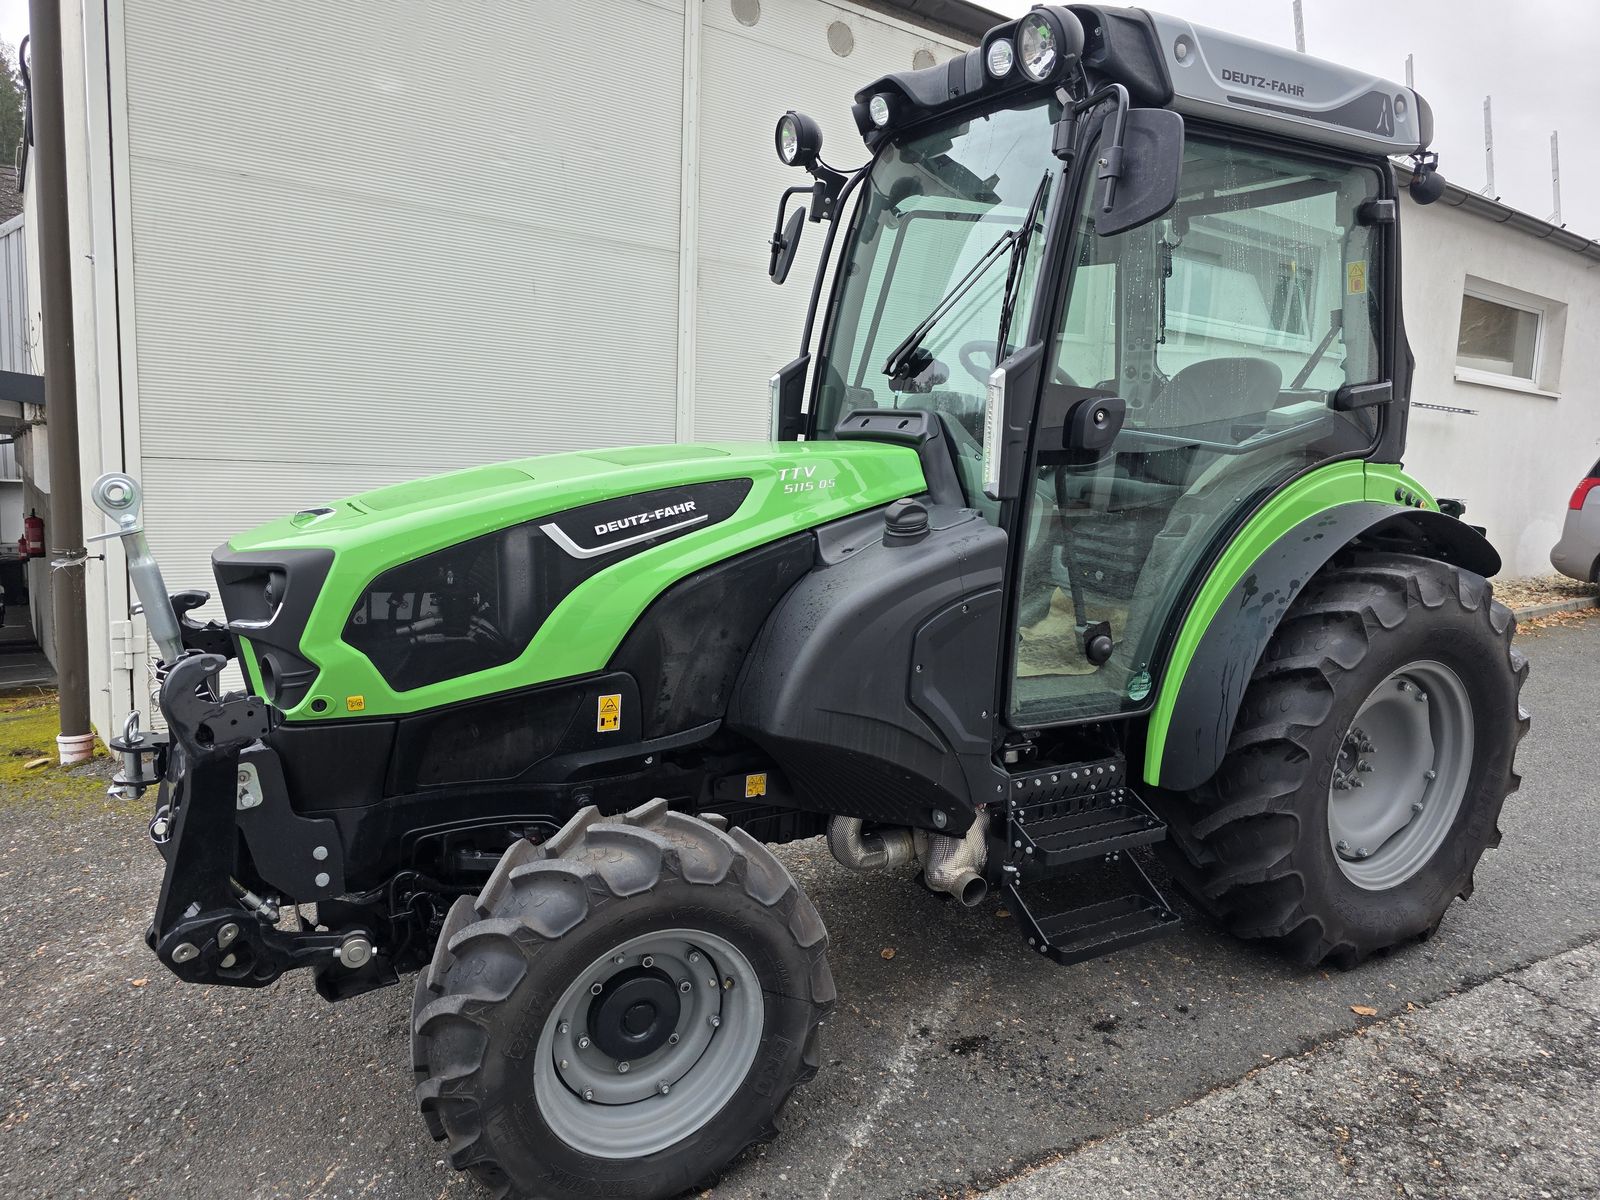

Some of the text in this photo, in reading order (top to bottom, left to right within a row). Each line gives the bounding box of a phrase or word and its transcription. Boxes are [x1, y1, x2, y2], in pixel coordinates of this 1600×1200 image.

[1221, 69, 1305, 97] DEUTZ-FAHR
[779, 465, 817, 481] TTV
[784, 481, 814, 494] 5115
[594, 500, 697, 536] DEUTZ-FAHR
